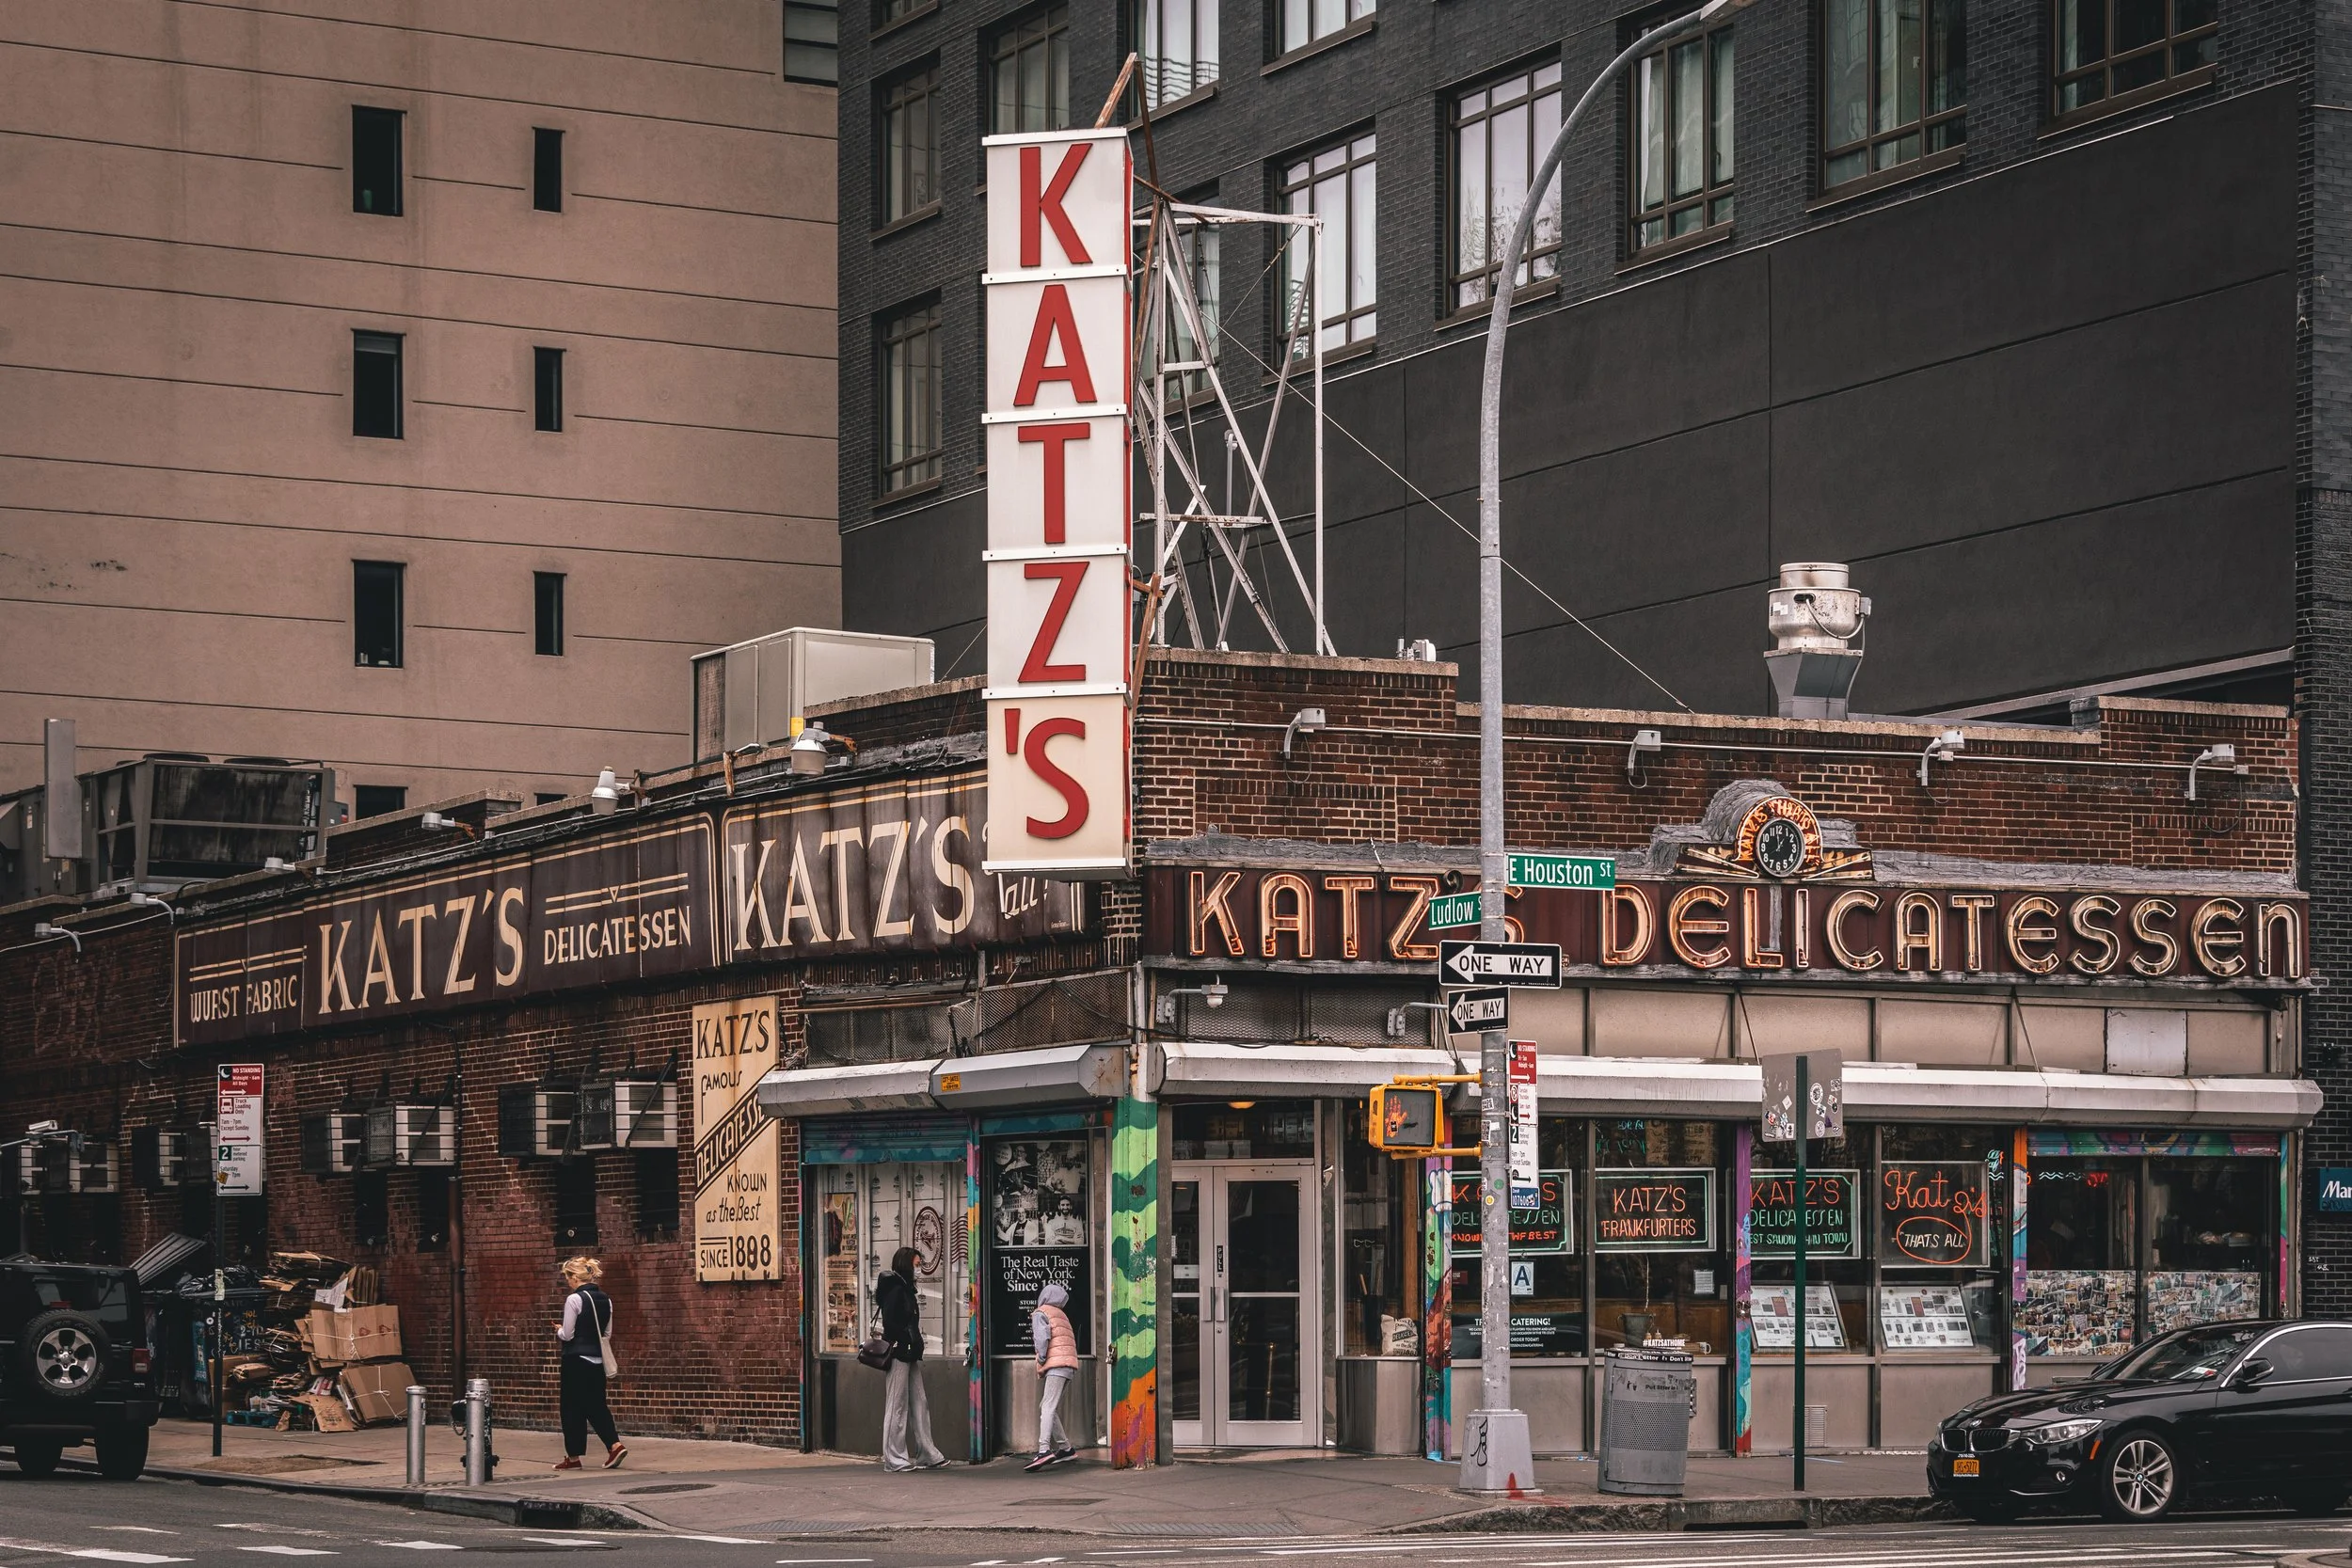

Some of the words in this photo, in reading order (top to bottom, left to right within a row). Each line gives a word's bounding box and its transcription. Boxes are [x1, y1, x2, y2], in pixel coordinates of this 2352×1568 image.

[1004, 143, 1097, 839] KATZ'S
[1763, 833, 1770, 843] 10
[1770, 828, 1775, 836] 11
[1775, 826, 1783, 834] 12
[1785, 828, 1788, 836] 1
[1789, 834, 1794, 843] 2
[1760, 843, 1766, 852] 9
[1791, 844, 1797, 853] 3
[1763, 853, 1769, 863] 8
[1769, 860, 1774, 868] 7
[1783, 860, 1788, 868] 5
[1788, 853, 1793, 863] 4
[1509, 858, 1518, 882] E
[1524, 858, 1593, 885] Houston
[1599, 862, 1612, 878] St
[1775, 862, 1781, 871] 6
[731, 815, 976, 952] KATZ'S
[1431, 898, 1474, 926] Ludlow
[544, 905, 691, 966] DELICATESSEN
[1601, 884, 2302, 979] DELICATESSEN
[318, 886, 524, 1015] KATZ'S
[1459, 955, 1493, 973] ONE
[1509, 957, 1545, 974] WAY
[190, 985, 240, 1023] WURST
[246, 974, 297, 1016] FABRIC
[1457, 1003, 1474, 1021] ONE
[1482, 1000, 1502, 1019] WAY
[696, 1009, 771, 1060] KATZ'S
[696, 1092, 765, 1188] DELICATESS
[1512, 1126, 1517, 1142] 2
[221, 1147, 229, 1160] 2
[727, 1172, 768, 1194] KNOWN
[1613, 1184, 1686, 1213] KATZ'S
[706, 1209, 717, 1224] as
[719, 1196, 736, 1223] the
[735, 1196, 762, 1223] Best
[1750, 1210, 1843, 1227] DELICAESSEN
[1601, 1218, 1696, 1238] FRANKFURTERS
[1750, 1233, 1763, 1243] EST
[700, 1248, 728, 1269] SINCE
[1001, 1256, 1020, 1268] The
[1024, 1256, 1048, 1268] Real
[1051, 1256, 1079, 1267] Taste
[1004, 1268, 1016, 1280] of
[1017, 1268, 1043, 1280] New
[1046, 1267, 1075, 1279] York.
[1514, 1265, 1531, 1286] A
[1008, 1279, 1038, 1292] Since
[1643, 1338, 1686, 1347] #KATZSATHOME
